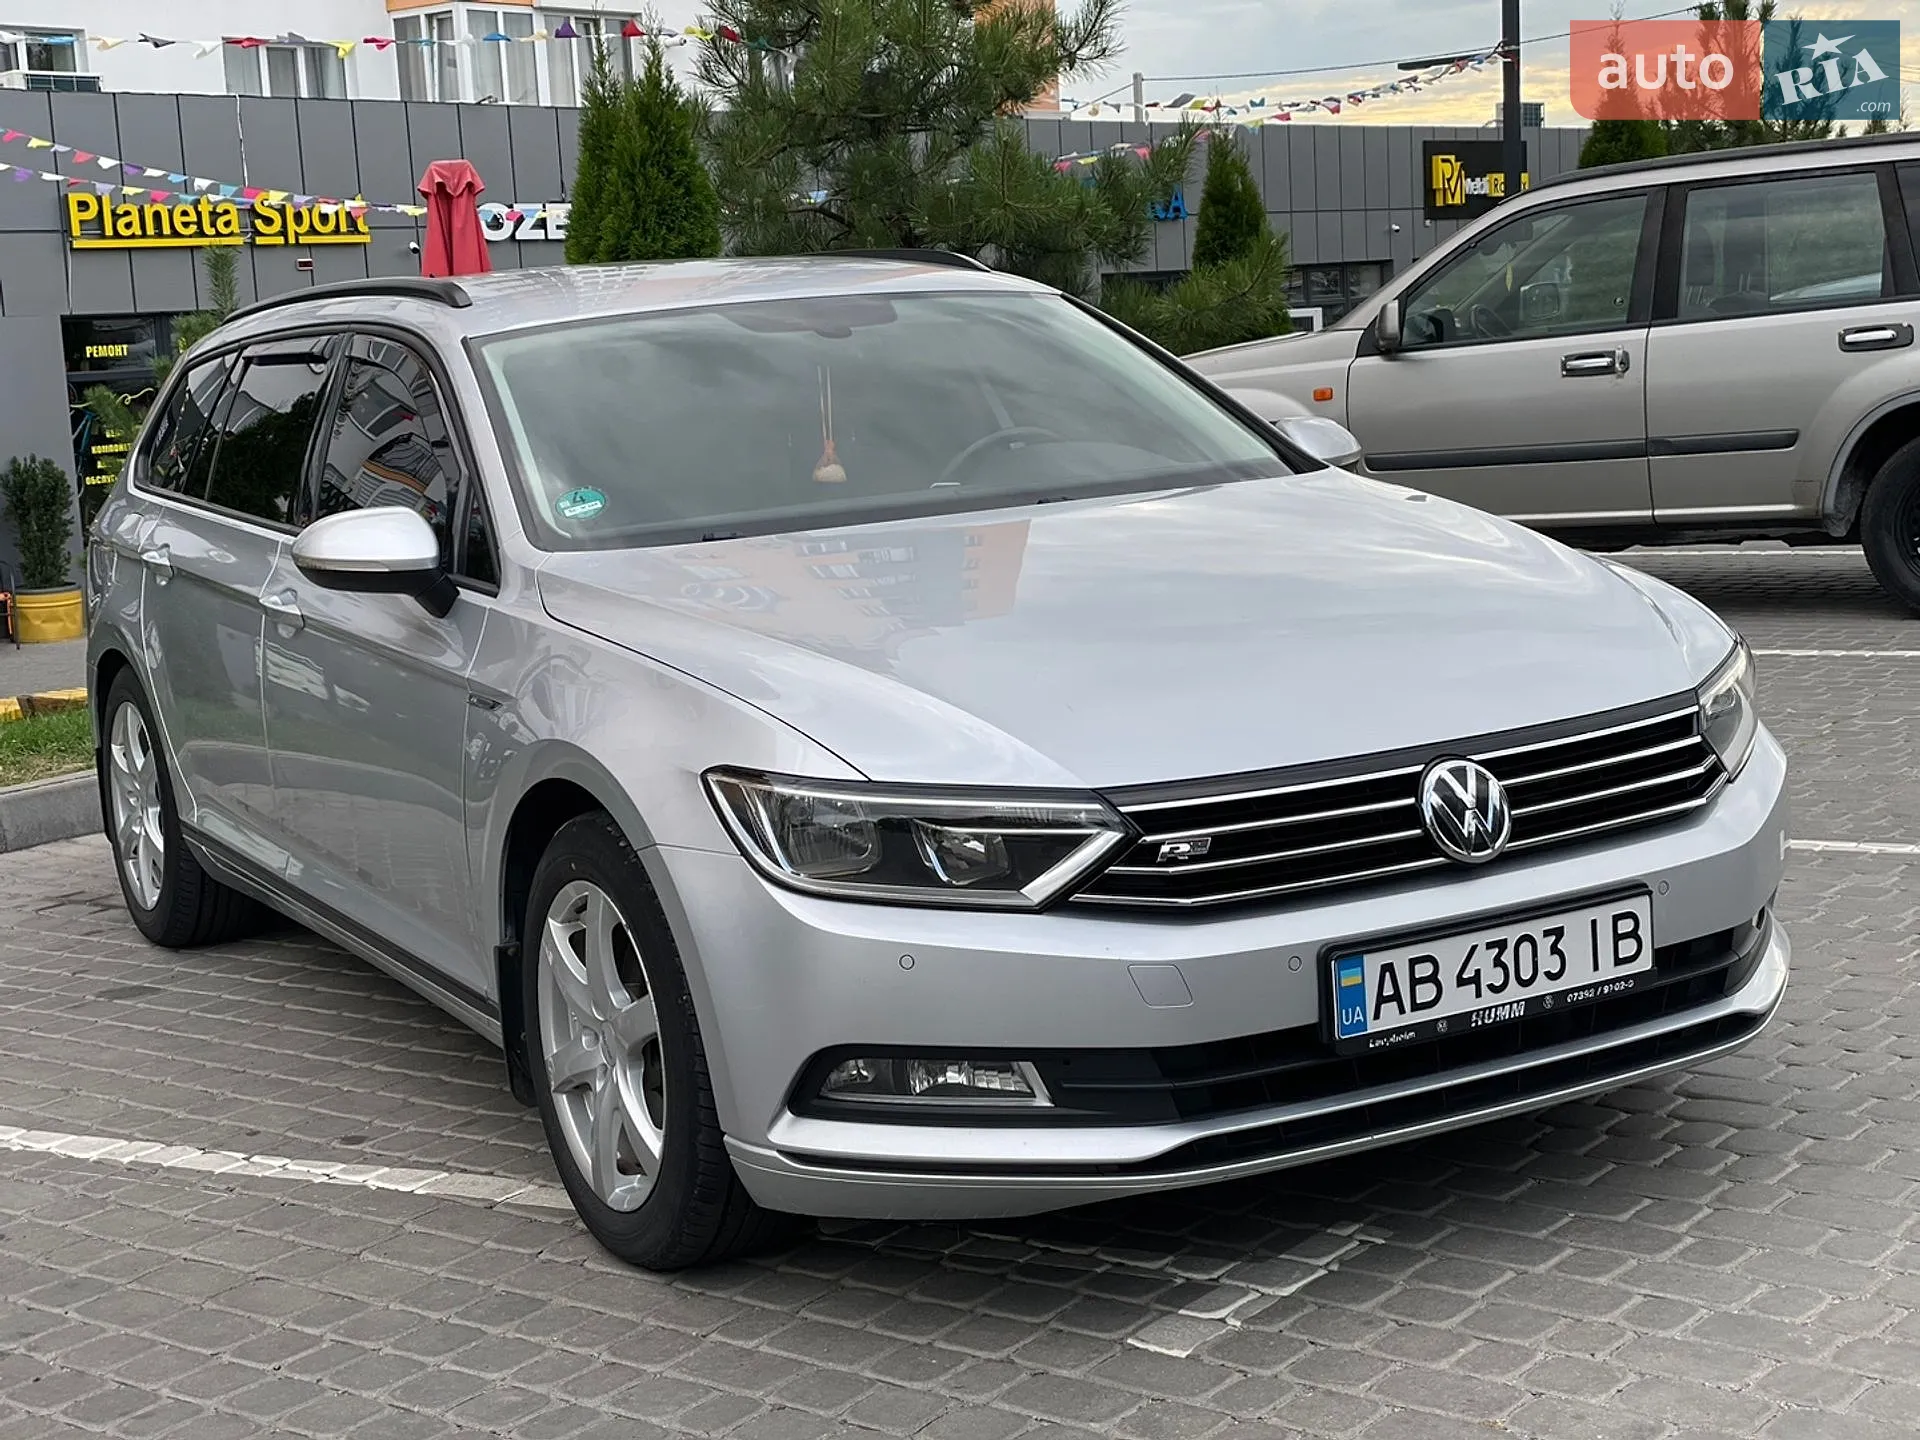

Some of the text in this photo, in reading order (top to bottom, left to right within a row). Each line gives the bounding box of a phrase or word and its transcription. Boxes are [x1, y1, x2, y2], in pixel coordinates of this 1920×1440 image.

[67, 191, 370, 245] Planeta Sport
[85, 344, 129, 358] РЕМОНТ
[1372, 910, 1645, 1022] AB 4303 IB
[1341, 1006, 1365, 1027] UA
